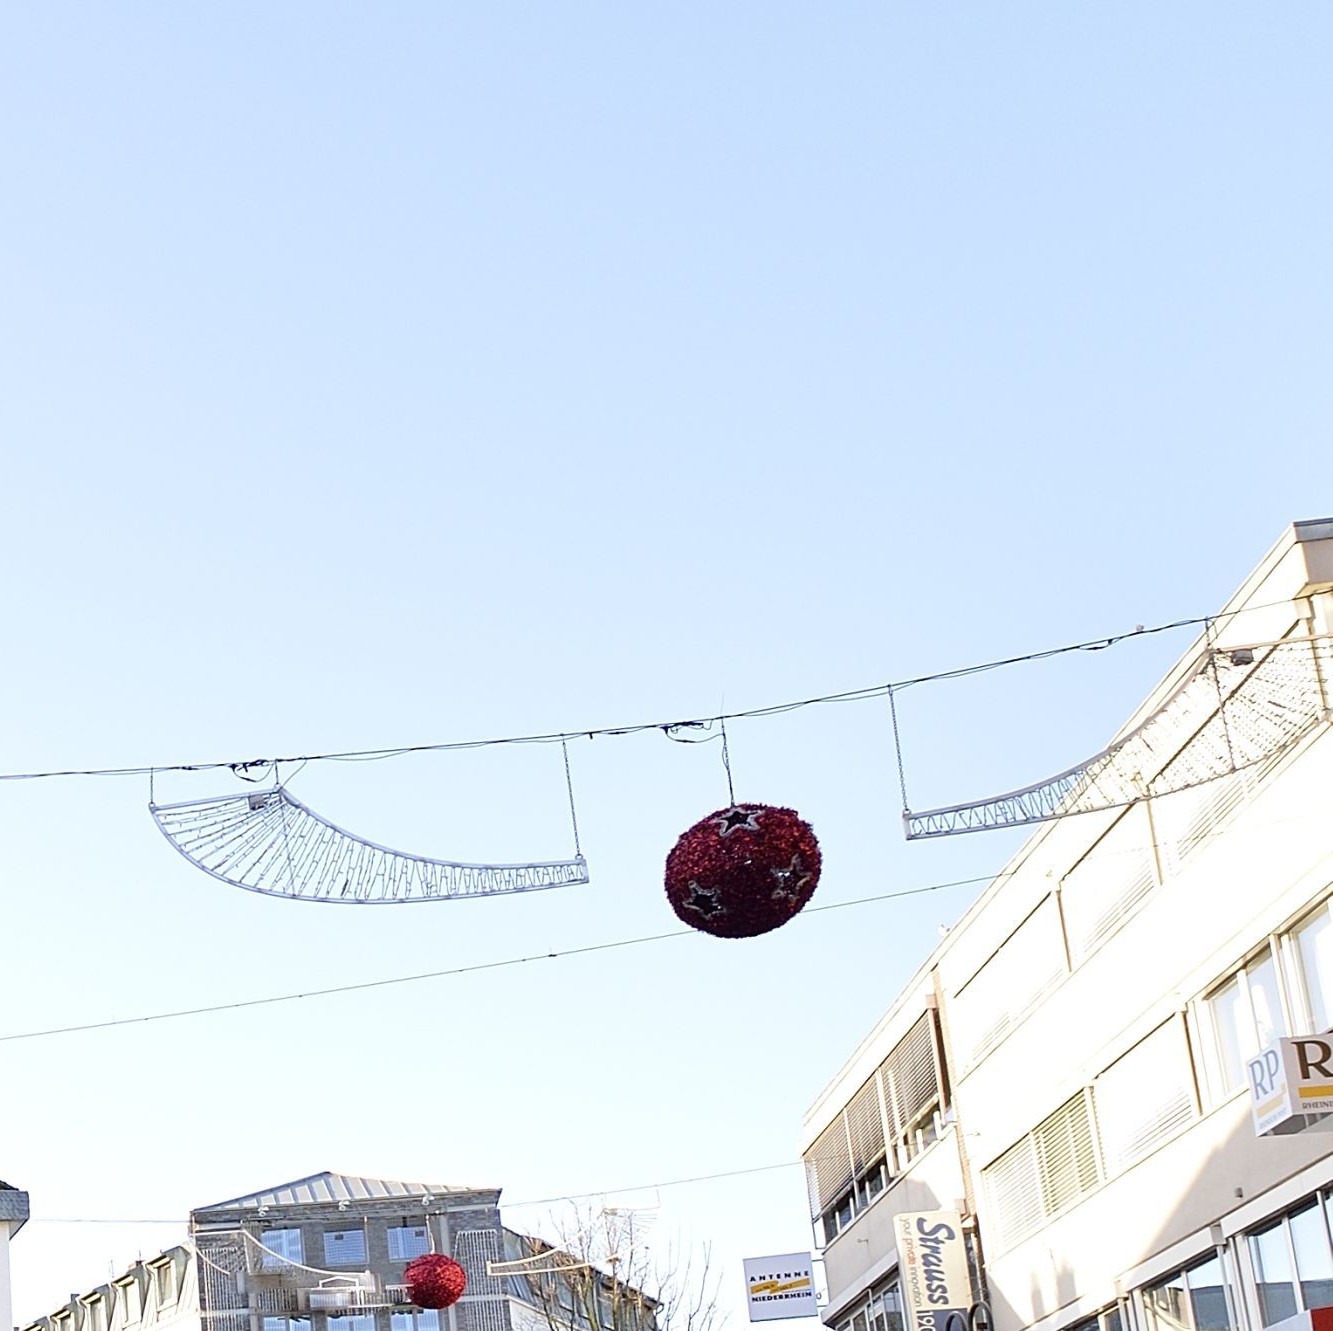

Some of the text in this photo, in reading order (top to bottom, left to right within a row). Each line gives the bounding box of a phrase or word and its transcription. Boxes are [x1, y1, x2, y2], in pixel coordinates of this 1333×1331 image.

[1249, 1049, 1279, 1100] RP
[750, 1271, 809, 1281] ANTENNE
[916, 1217, 955, 1305] Strauss
[752, 1292, 812, 1302] NIEDERRHEIN
